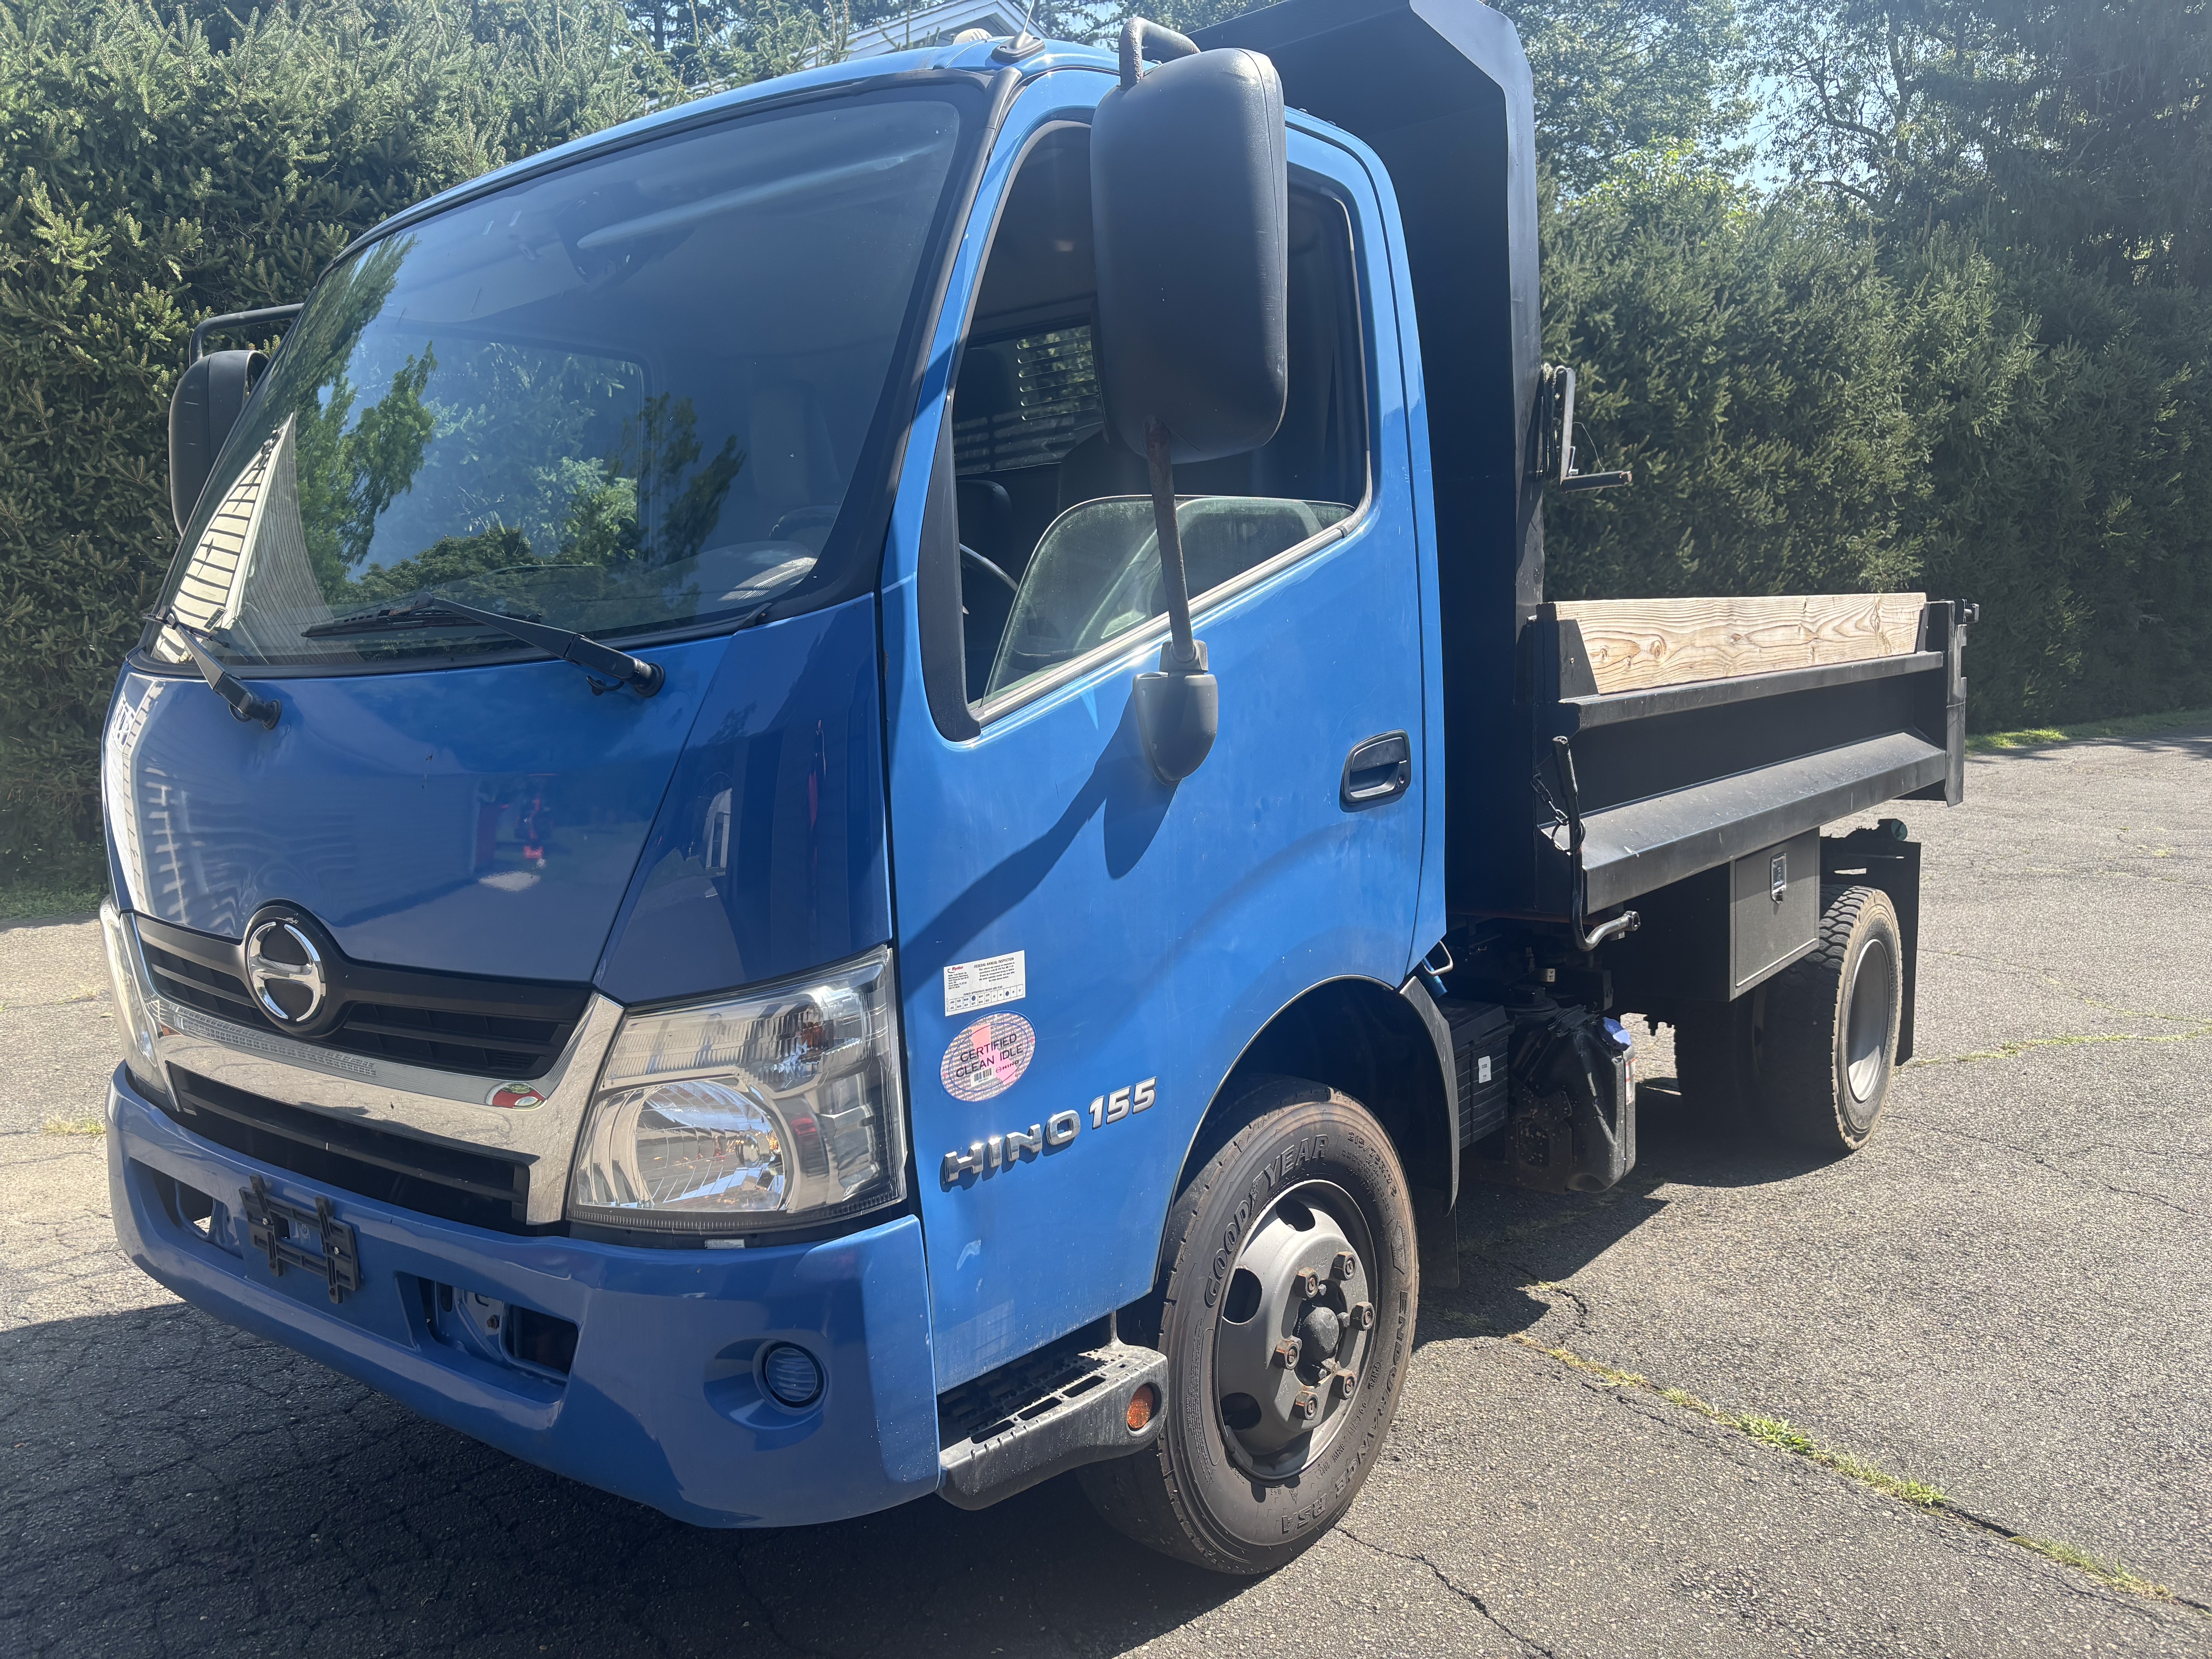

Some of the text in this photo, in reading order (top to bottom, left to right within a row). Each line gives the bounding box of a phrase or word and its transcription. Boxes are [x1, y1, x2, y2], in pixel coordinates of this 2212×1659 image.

[956, 1044, 1024, 1077] CLEAN IDLE
[960, 1033, 1017, 1062] CERTIFIED
[1002, 1060, 1019, 1070] HINO
[944, 1076, 1157, 1183] HINO 155
[1282, 1493, 1327, 1535] RSA
